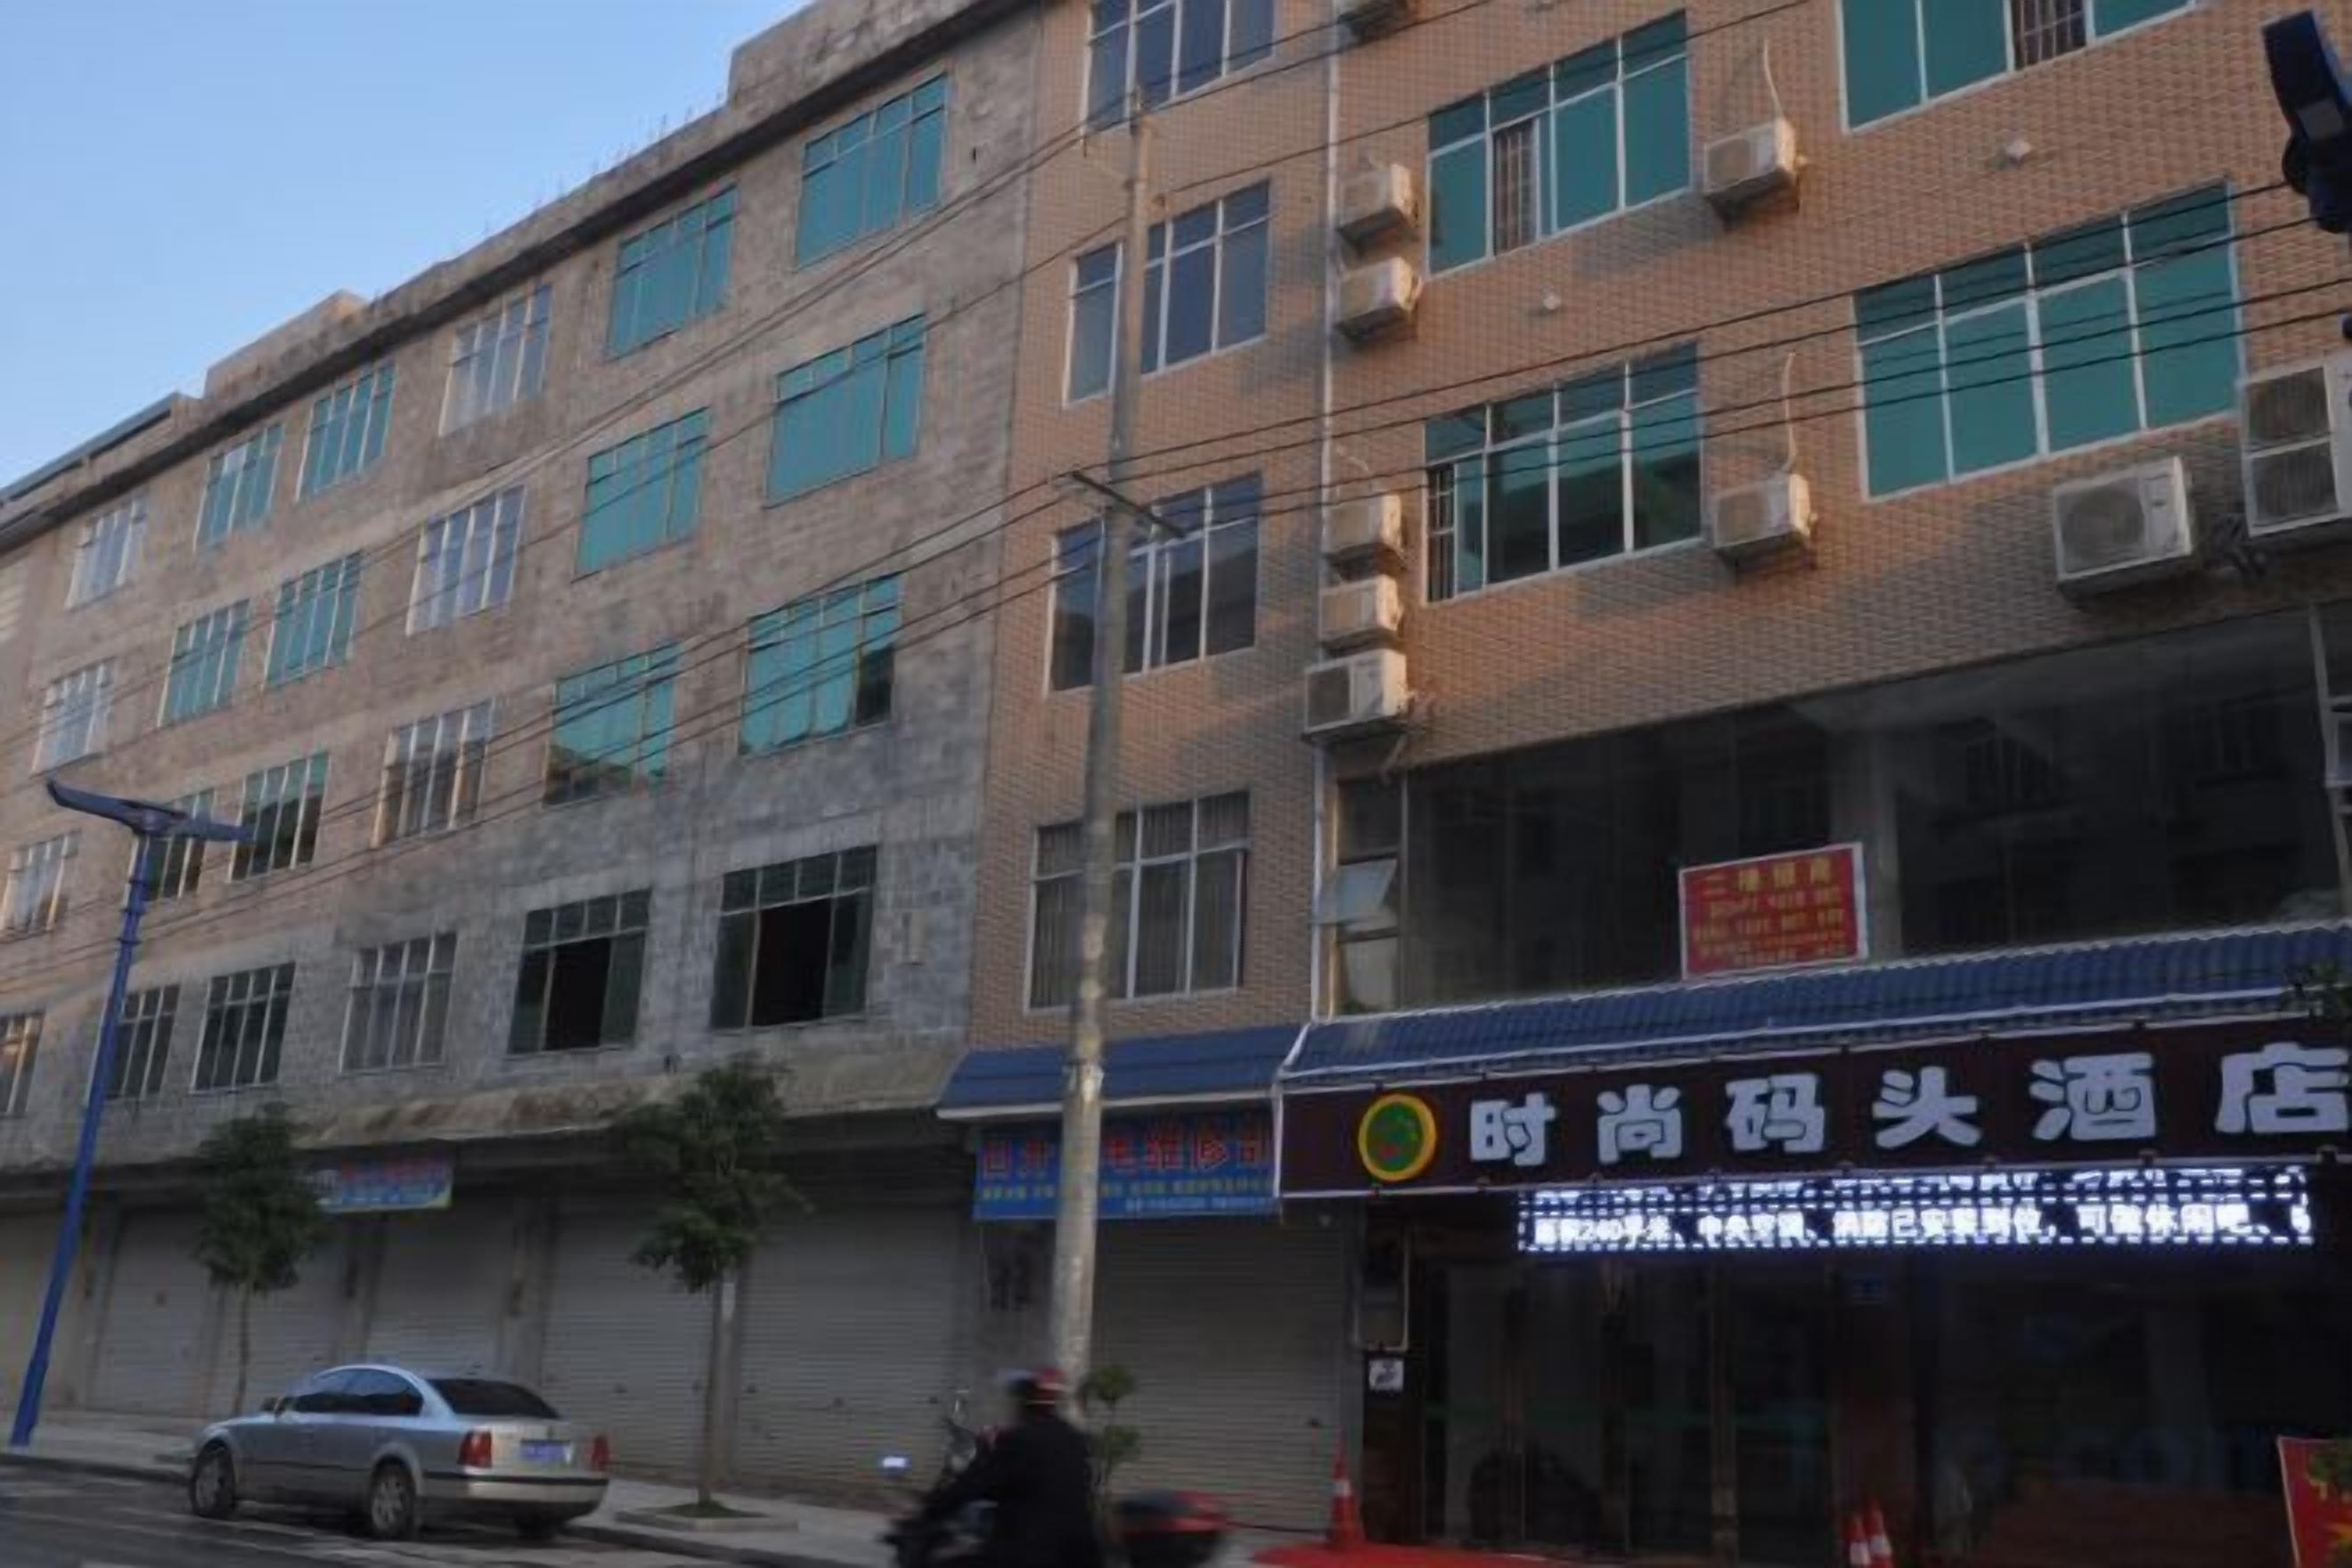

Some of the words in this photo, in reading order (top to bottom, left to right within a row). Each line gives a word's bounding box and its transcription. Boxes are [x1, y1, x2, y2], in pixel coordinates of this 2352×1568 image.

[1469, 1041, 2350, 1166] 时尚码头酒店
